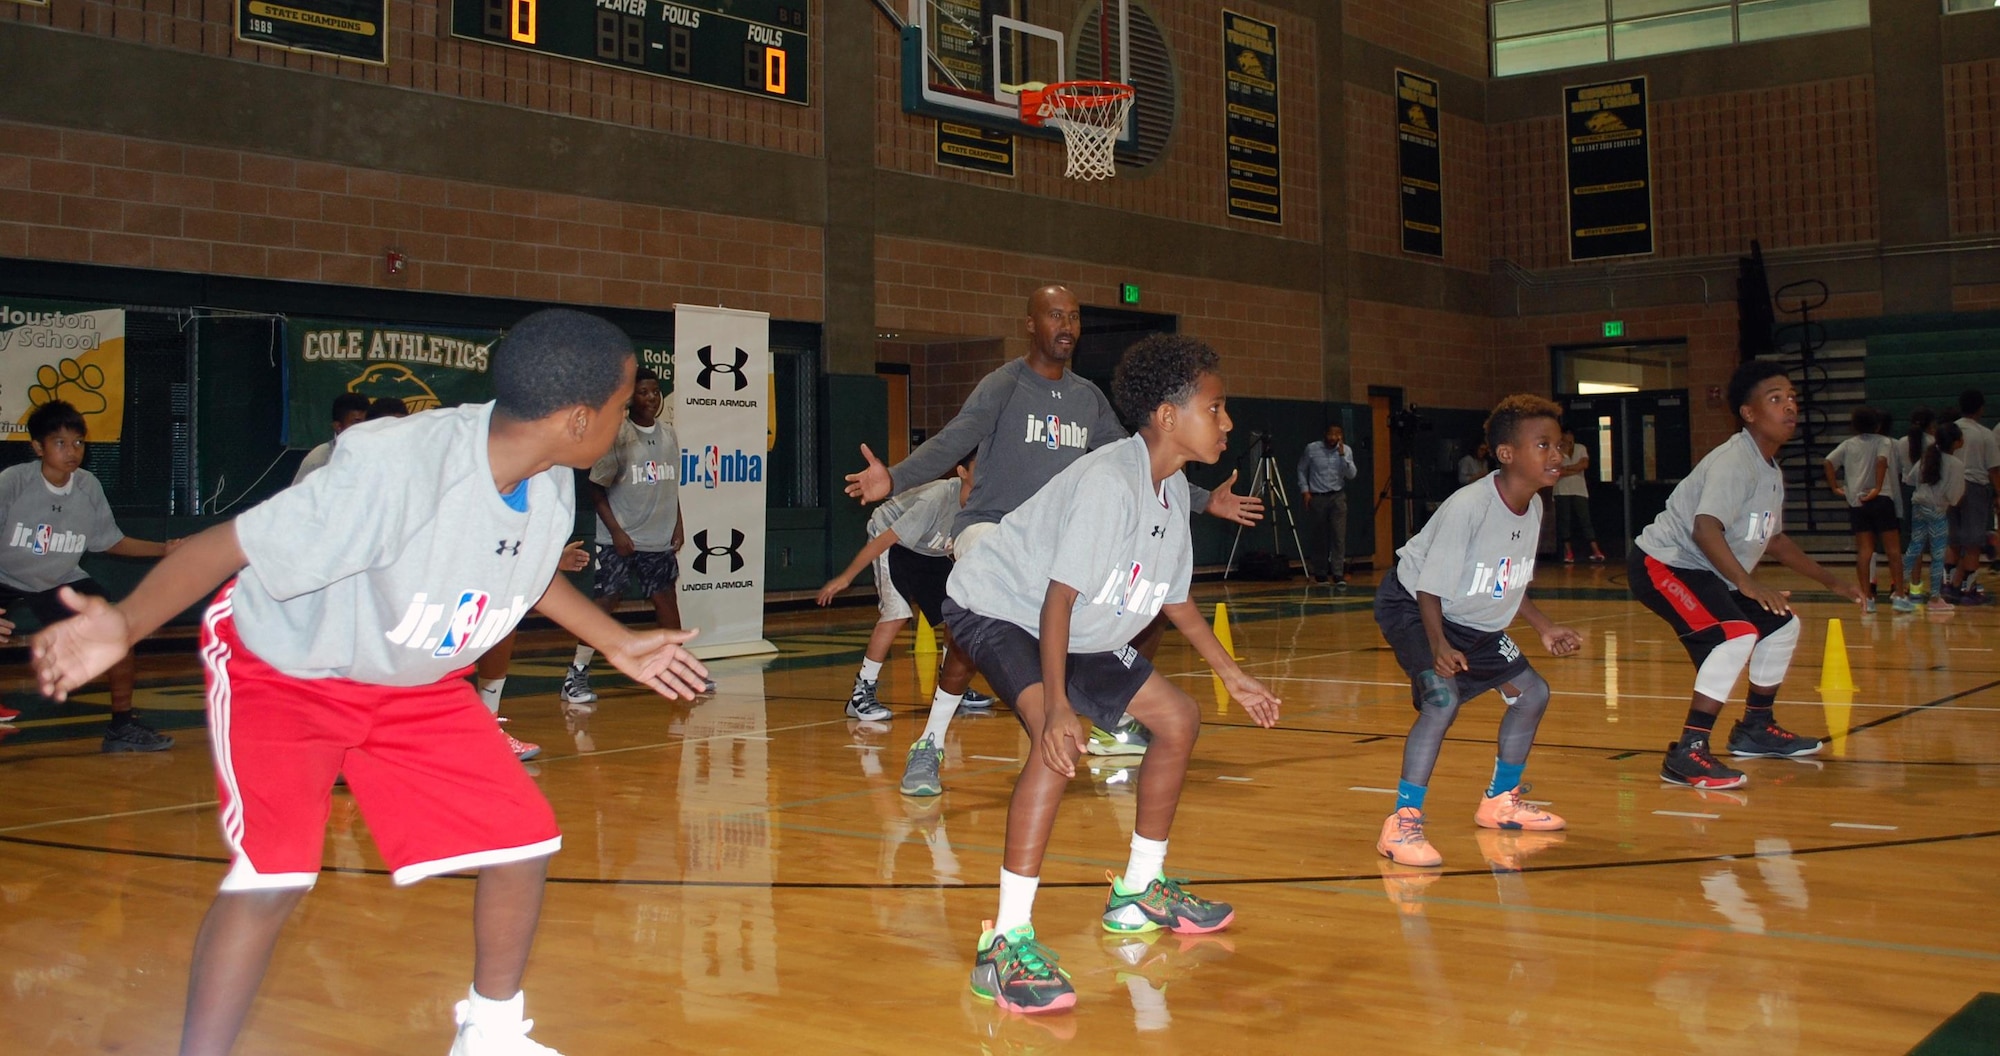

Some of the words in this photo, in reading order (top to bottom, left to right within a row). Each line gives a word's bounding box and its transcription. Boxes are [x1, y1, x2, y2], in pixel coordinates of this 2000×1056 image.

[250, 18, 272, 34] 1989
[265, 6, 298, 19] STATE
[301, 12, 361, 31] CHAMPIONS
[662, 5, 700, 28] FOULS
[747, 24, 783, 47] FOULS
[765, 47, 786, 94] 0
[947, 145, 967, 154] STATE
[969, 148, 1004, 161] CHAMPIONS
[18, 327, 101, 350] School
[304, 331, 362, 360] COLE
[368, 330, 489, 372] ATHLETICS
[686, 398, 717, 407] UNDER
[720, 399, 757, 408] ARMOUR
[1025, 414, 1046, 443] jr.
[1060, 421, 1088, 449] nba
[680, 448, 702, 486] jr.
[721, 449, 762, 483] nba
[10, 522, 32, 548] jr.
[49, 530, 86, 553] nba
[682, 582, 713, 592] UNDER
[715, 580, 753, 590] ARMOUR
[1467, 562, 1493, 596] jr.
[385, 592, 444, 649] jr.
